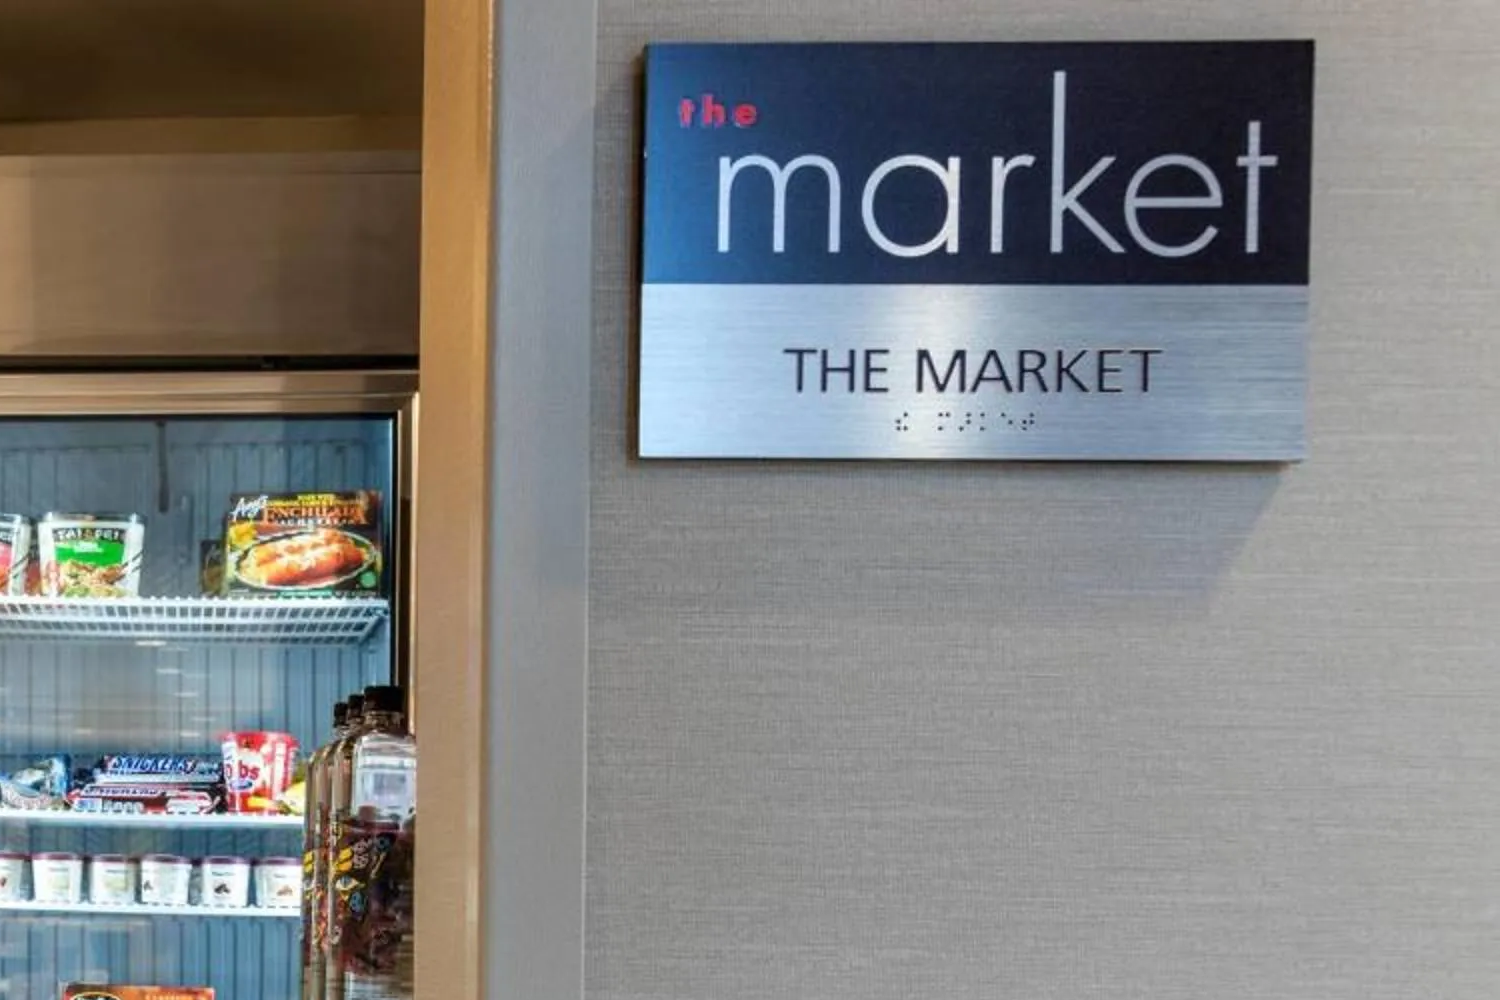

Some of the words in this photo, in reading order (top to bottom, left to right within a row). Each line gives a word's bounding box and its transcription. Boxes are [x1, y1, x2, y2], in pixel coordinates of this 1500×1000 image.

[679, 94, 759, 128] the
[717, 71, 1279, 258] market
[783, 347, 890, 394] THE
[915, 347, 1164, 394] MARKET
